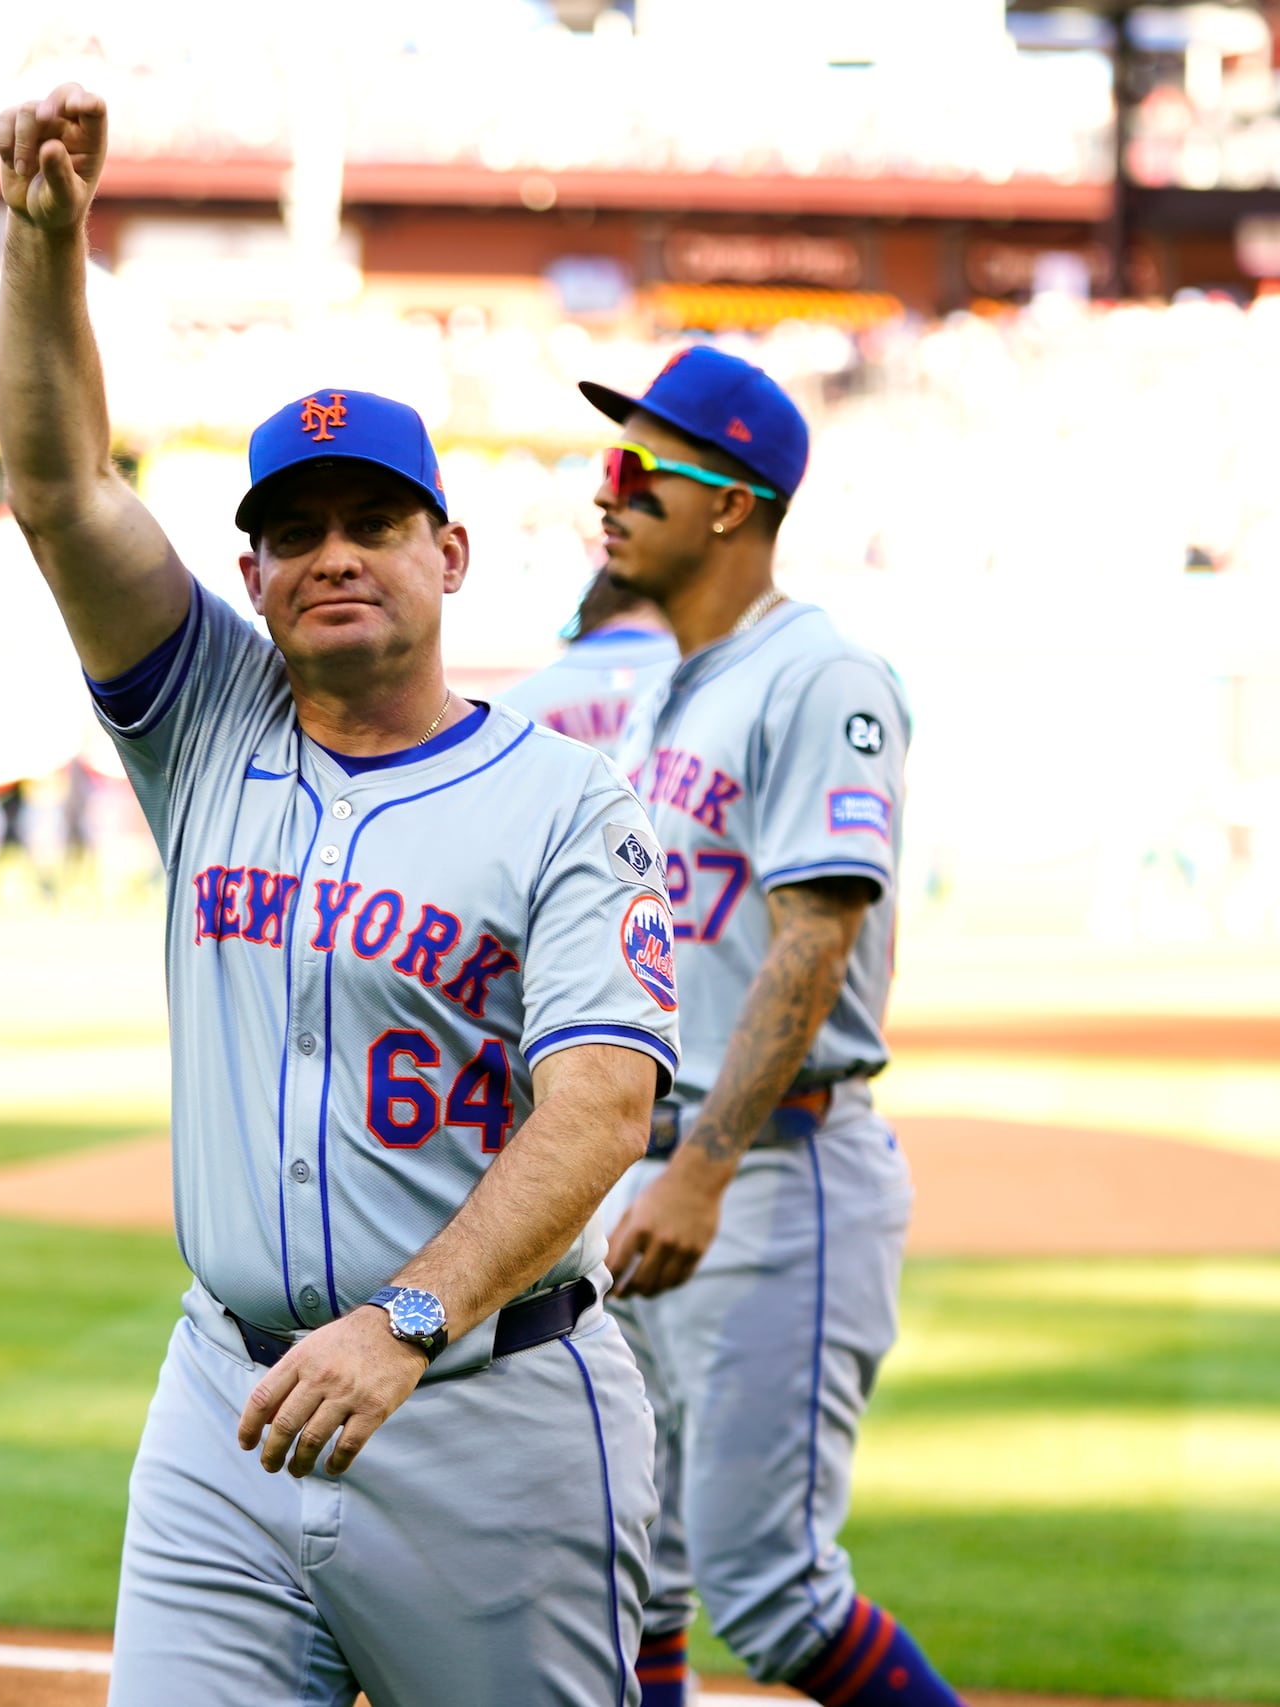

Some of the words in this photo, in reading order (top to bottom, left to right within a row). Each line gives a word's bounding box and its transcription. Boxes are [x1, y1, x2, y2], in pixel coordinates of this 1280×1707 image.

[301, 393, 347, 441] NY
[848, 716, 882, 753] 24
[193, 865, 300, 949] NEW
[310, 879, 521, 1018] YORK
[666, 849, 752, 944] 27
[366, 1028, 515, 1154] 64
